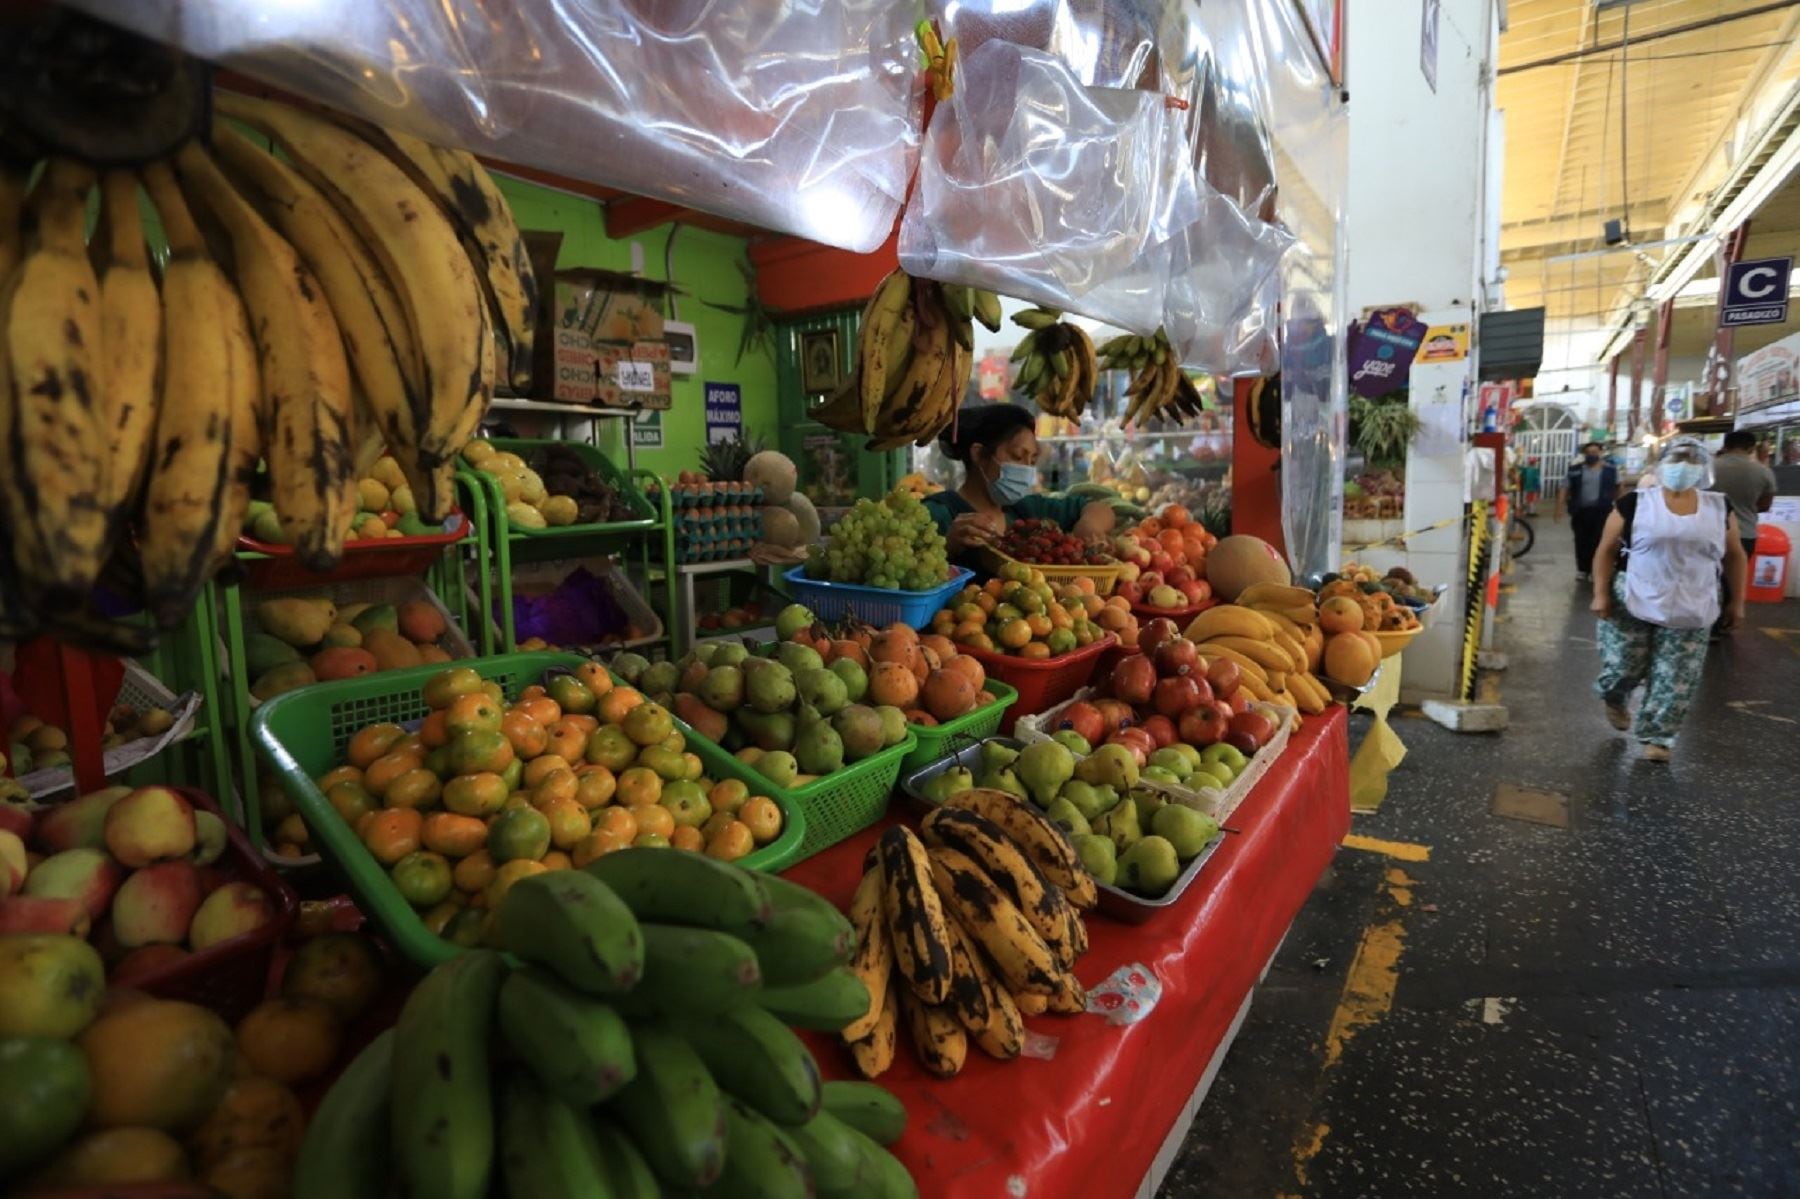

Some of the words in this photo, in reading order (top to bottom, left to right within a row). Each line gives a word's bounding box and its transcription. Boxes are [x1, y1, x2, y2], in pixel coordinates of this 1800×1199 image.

[1739, 267, 1777, 298] C
[1727, 309, 1779, 321] PASADIZO
[1353, 360, 1396, 381] yape
[708, 390, 737, 403] AFORO
[706, 408, 740, 423] MÁXIMO
[634, 431, 659, 441] ALIDA
